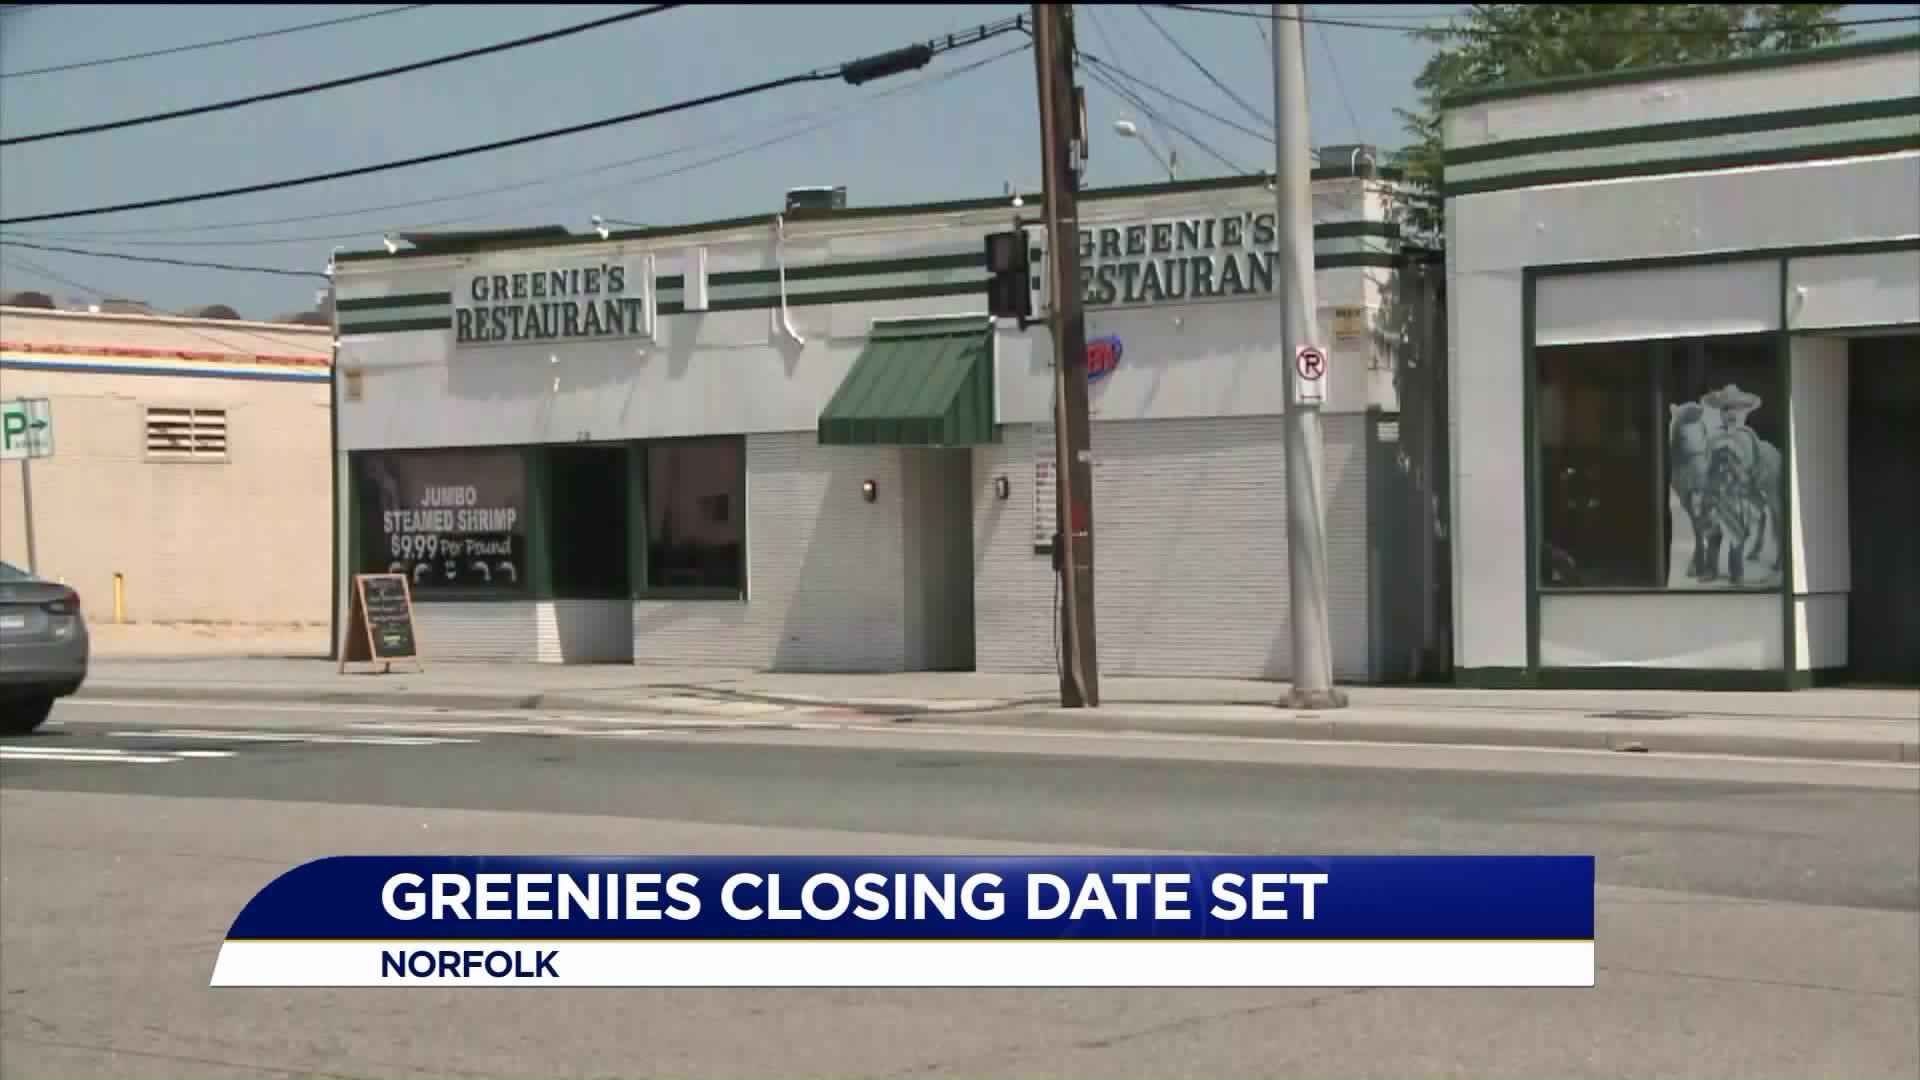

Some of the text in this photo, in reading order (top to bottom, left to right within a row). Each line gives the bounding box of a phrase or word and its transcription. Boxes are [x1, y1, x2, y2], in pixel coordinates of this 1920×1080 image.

[1080, 212, 1275, 257] GREENIE'S
[471, 264, 624, 301] GREENIE'S
[1080, 252, 1280, 305] ESTAURAN
[455, 298, 642, 342] RESTAURANT
[4, 411, 26, 449] P
[421, 486, 477, 507] JUMBO
[384, 508, 517, 533] STEAMED SHRIMP
[391, 535, 438, 559] $9.99
[466, 538, 512, 556] Pound
